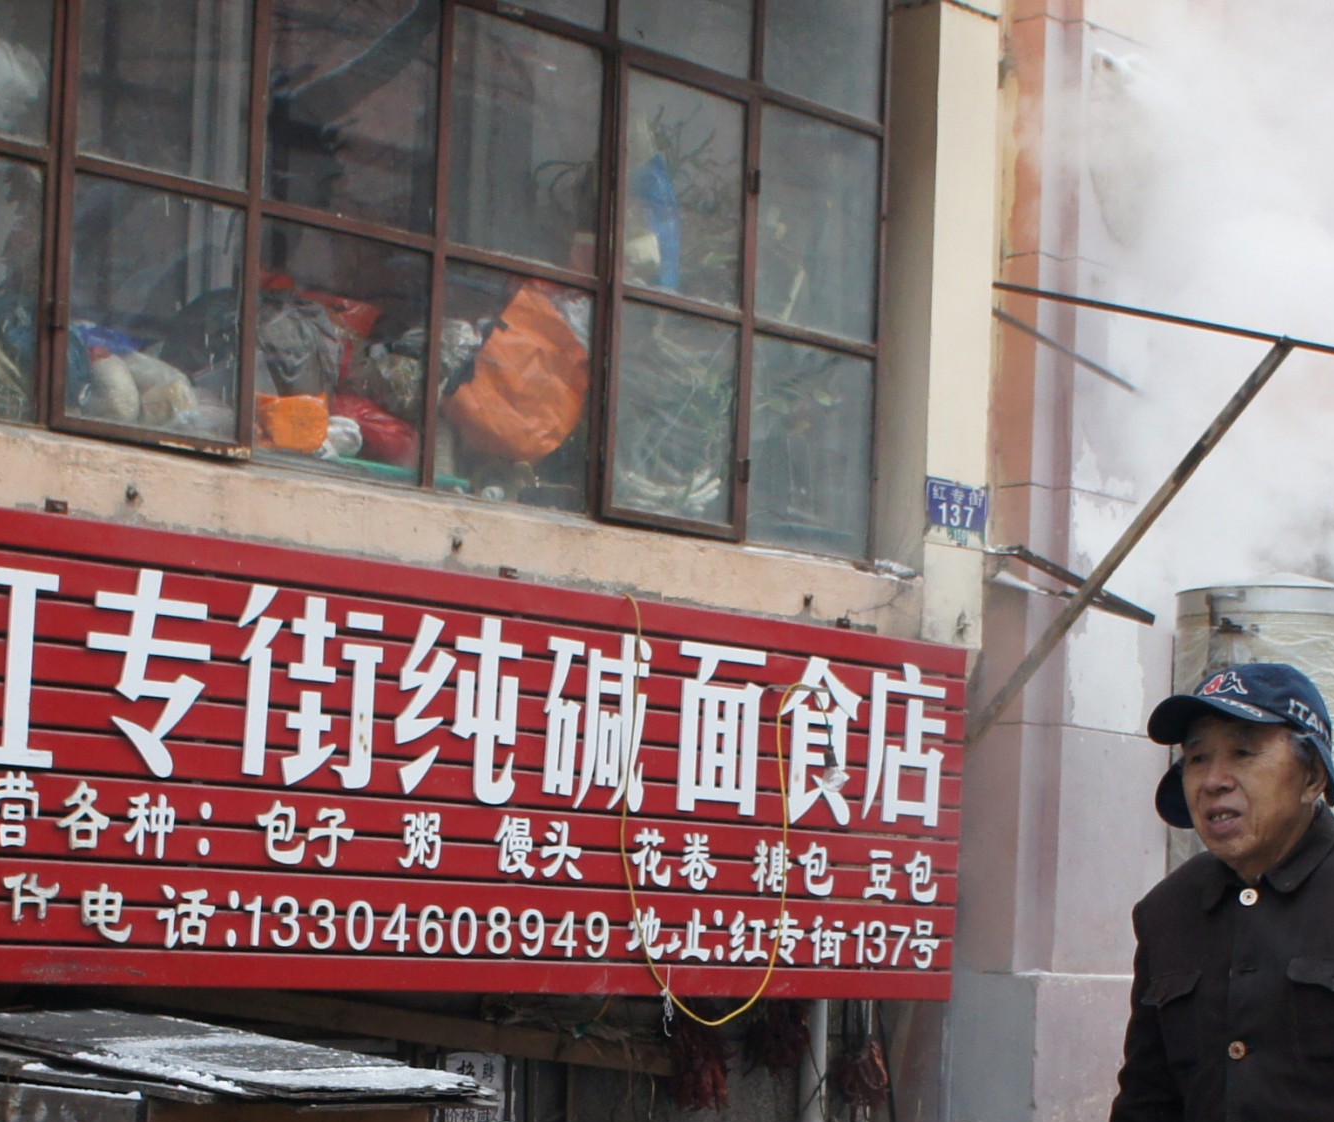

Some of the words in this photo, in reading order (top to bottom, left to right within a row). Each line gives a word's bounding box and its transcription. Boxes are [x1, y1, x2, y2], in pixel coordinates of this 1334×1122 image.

[938, 502, 974, 528] 137
[256, 799, 354, 868] 包子
[397, 811, 442, 869] 粥
[494, 814, 583, 880] 馒头
[631, 827, 717, 891] 花卷
[751, 839, 834, 897] 糖包
[863, 849, 938, 903] 豆包
